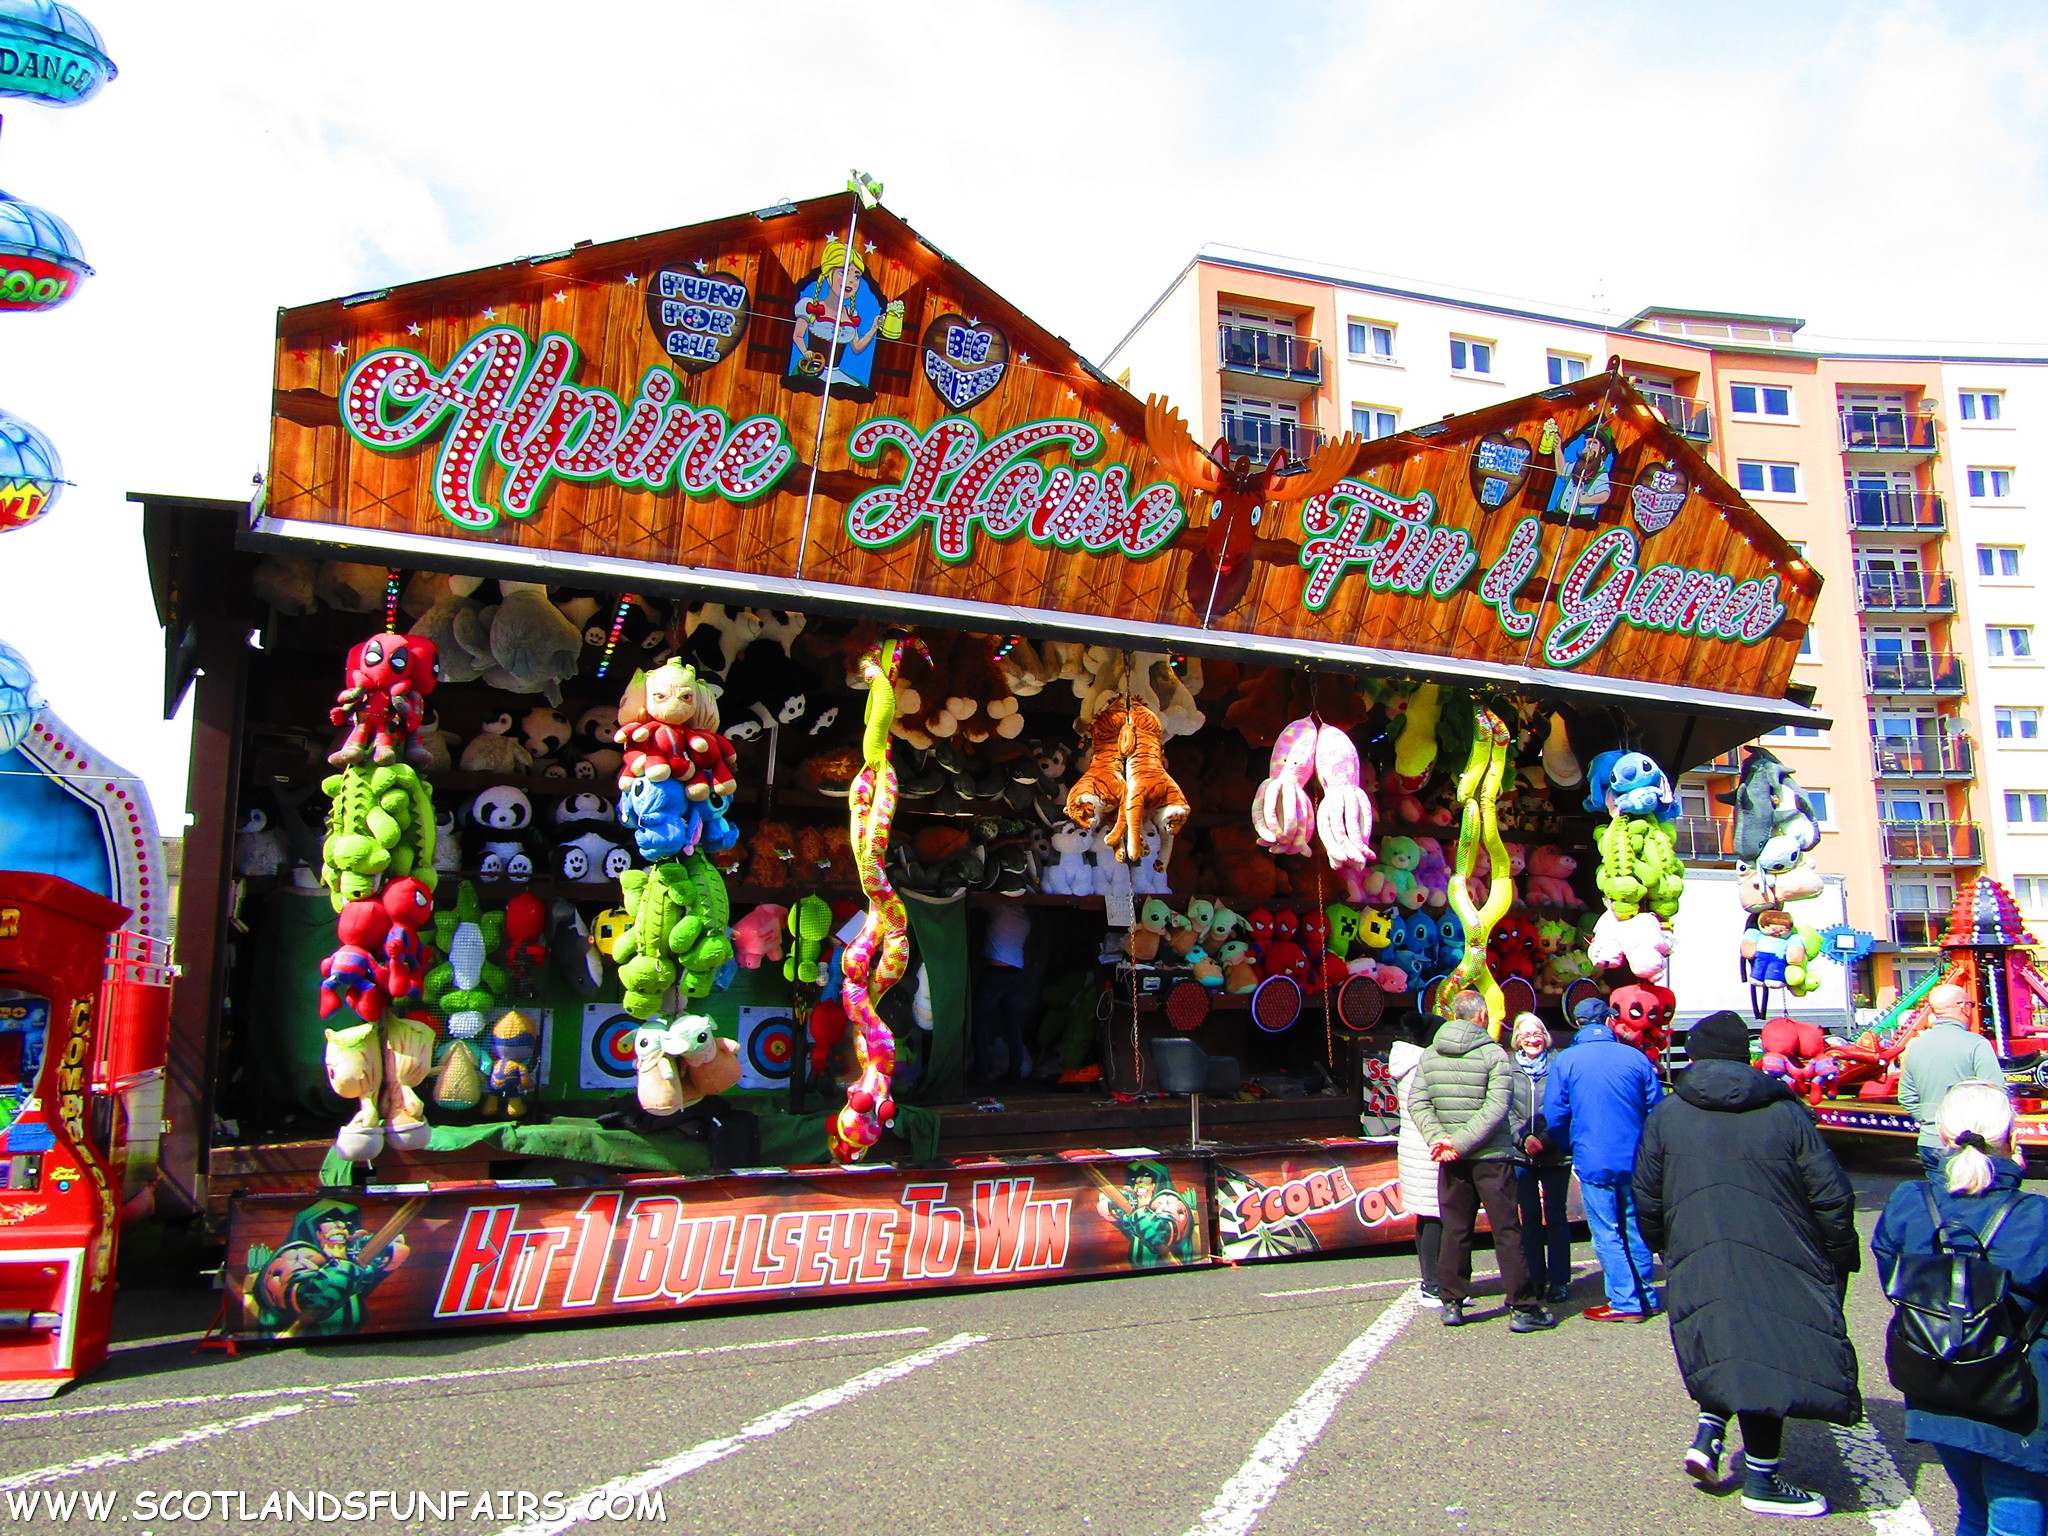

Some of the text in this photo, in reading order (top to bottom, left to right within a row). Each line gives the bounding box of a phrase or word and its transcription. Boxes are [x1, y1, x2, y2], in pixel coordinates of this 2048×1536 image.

[660, 270, 746, 310] FUN
[661, 299, 736, 337] FOR
[666, 330, 721, 363] ALL
[946, 325, 993, 365] BIG
[1478, 441, 1531, 476] FAMILY
[342, 325, 793, 528] Alpine
[845, 416, 1186, 560] House
[1300, 478, 1478, 611] Fun
[1543, 526, 1786, 667] Games
[1480, 476, 1509, 506] FUN
[1235, 1165, 1408, 1239] SCORE OV
[433, 1176, 1073, 1318] HIT 1 BULLSEYE TO WIN
